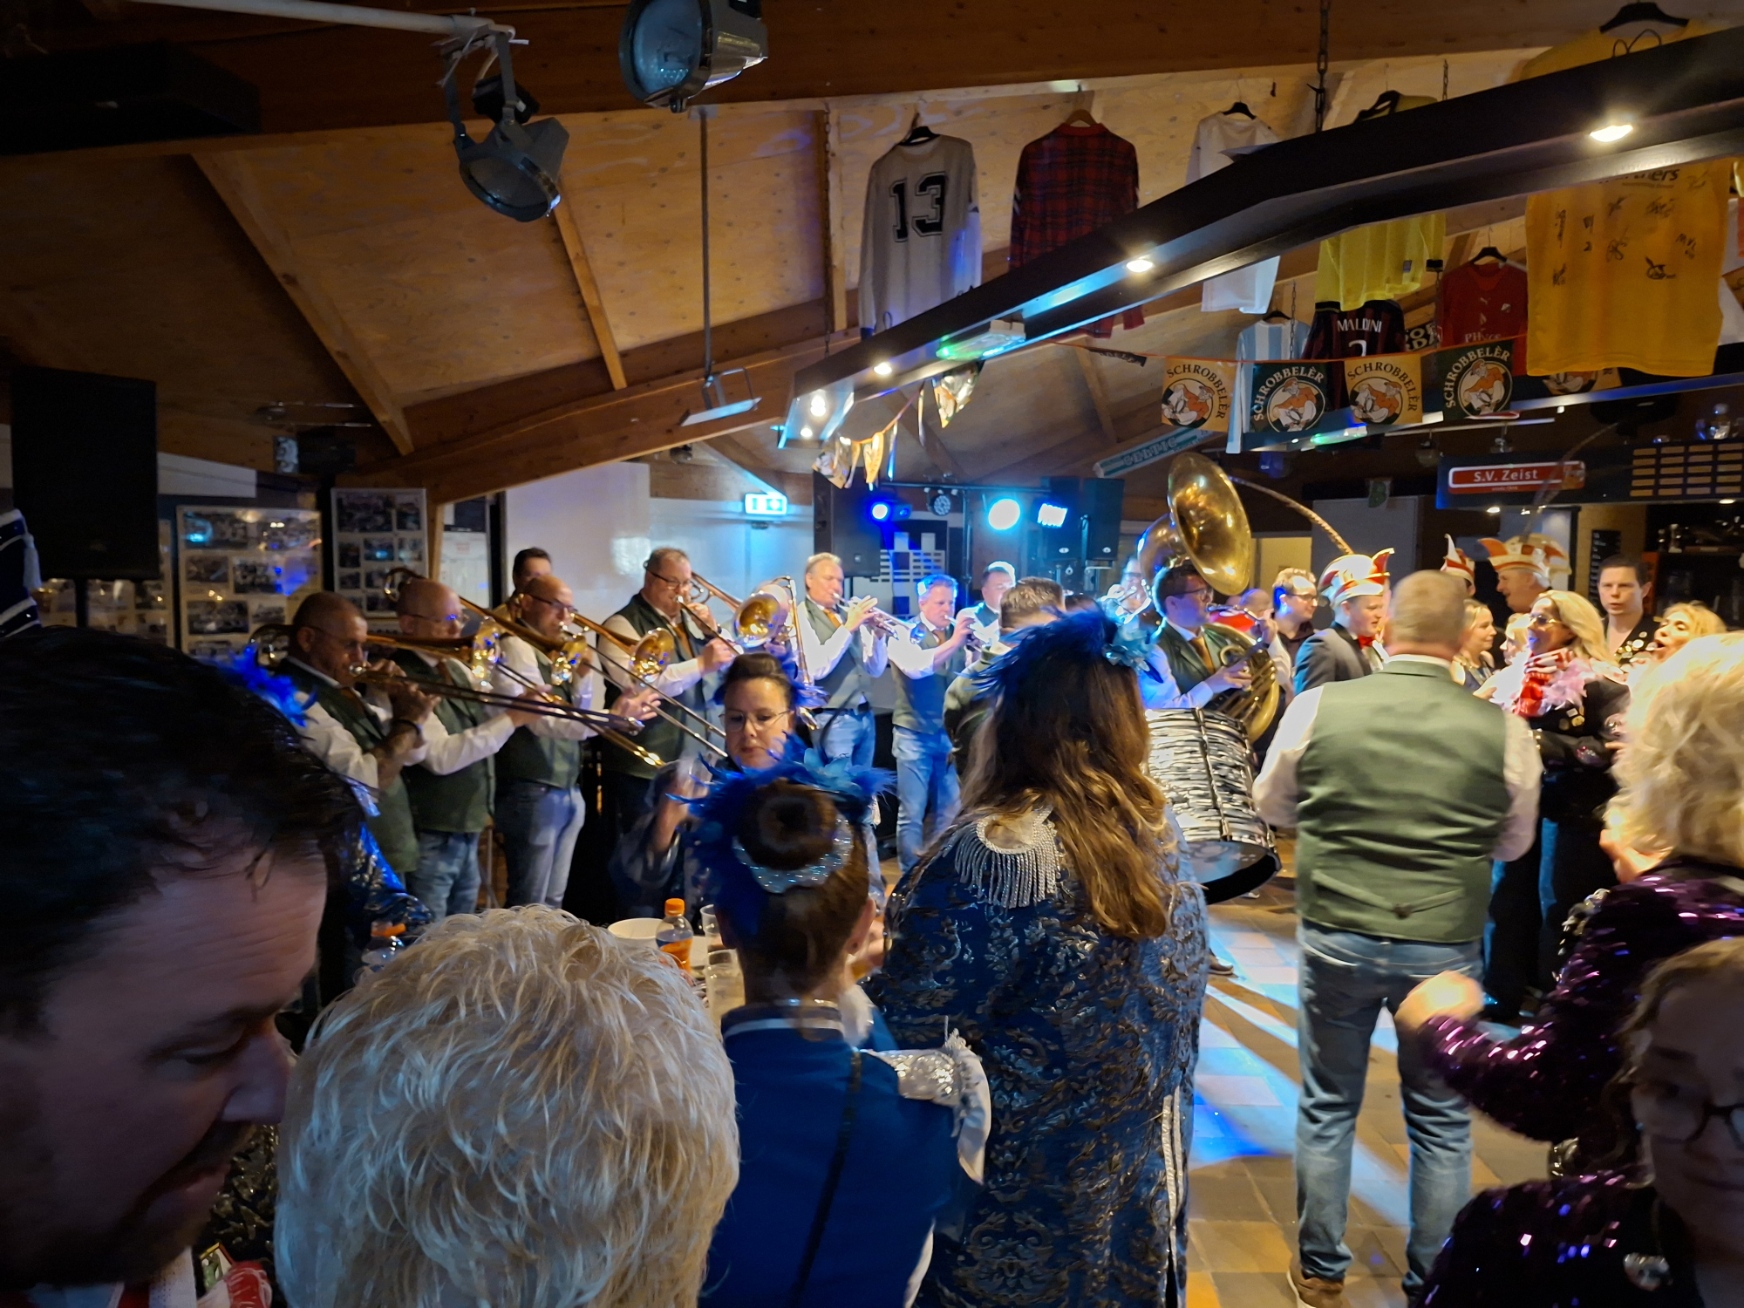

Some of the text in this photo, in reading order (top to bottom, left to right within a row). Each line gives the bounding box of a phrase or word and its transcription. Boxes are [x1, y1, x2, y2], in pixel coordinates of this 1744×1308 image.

[887, 171, 947, 243] 13
[1337, 318, 1383, 333] MALDINI
[1253, 366, 1325, 421] SCHROBBELÈR
[1347, 361, 1418, 412] SCHROBBELÈR
[1443, 345, 1511, 408] SCHROBBELÈR
[1473, 469, 1539, 482] S.V. Zeist
